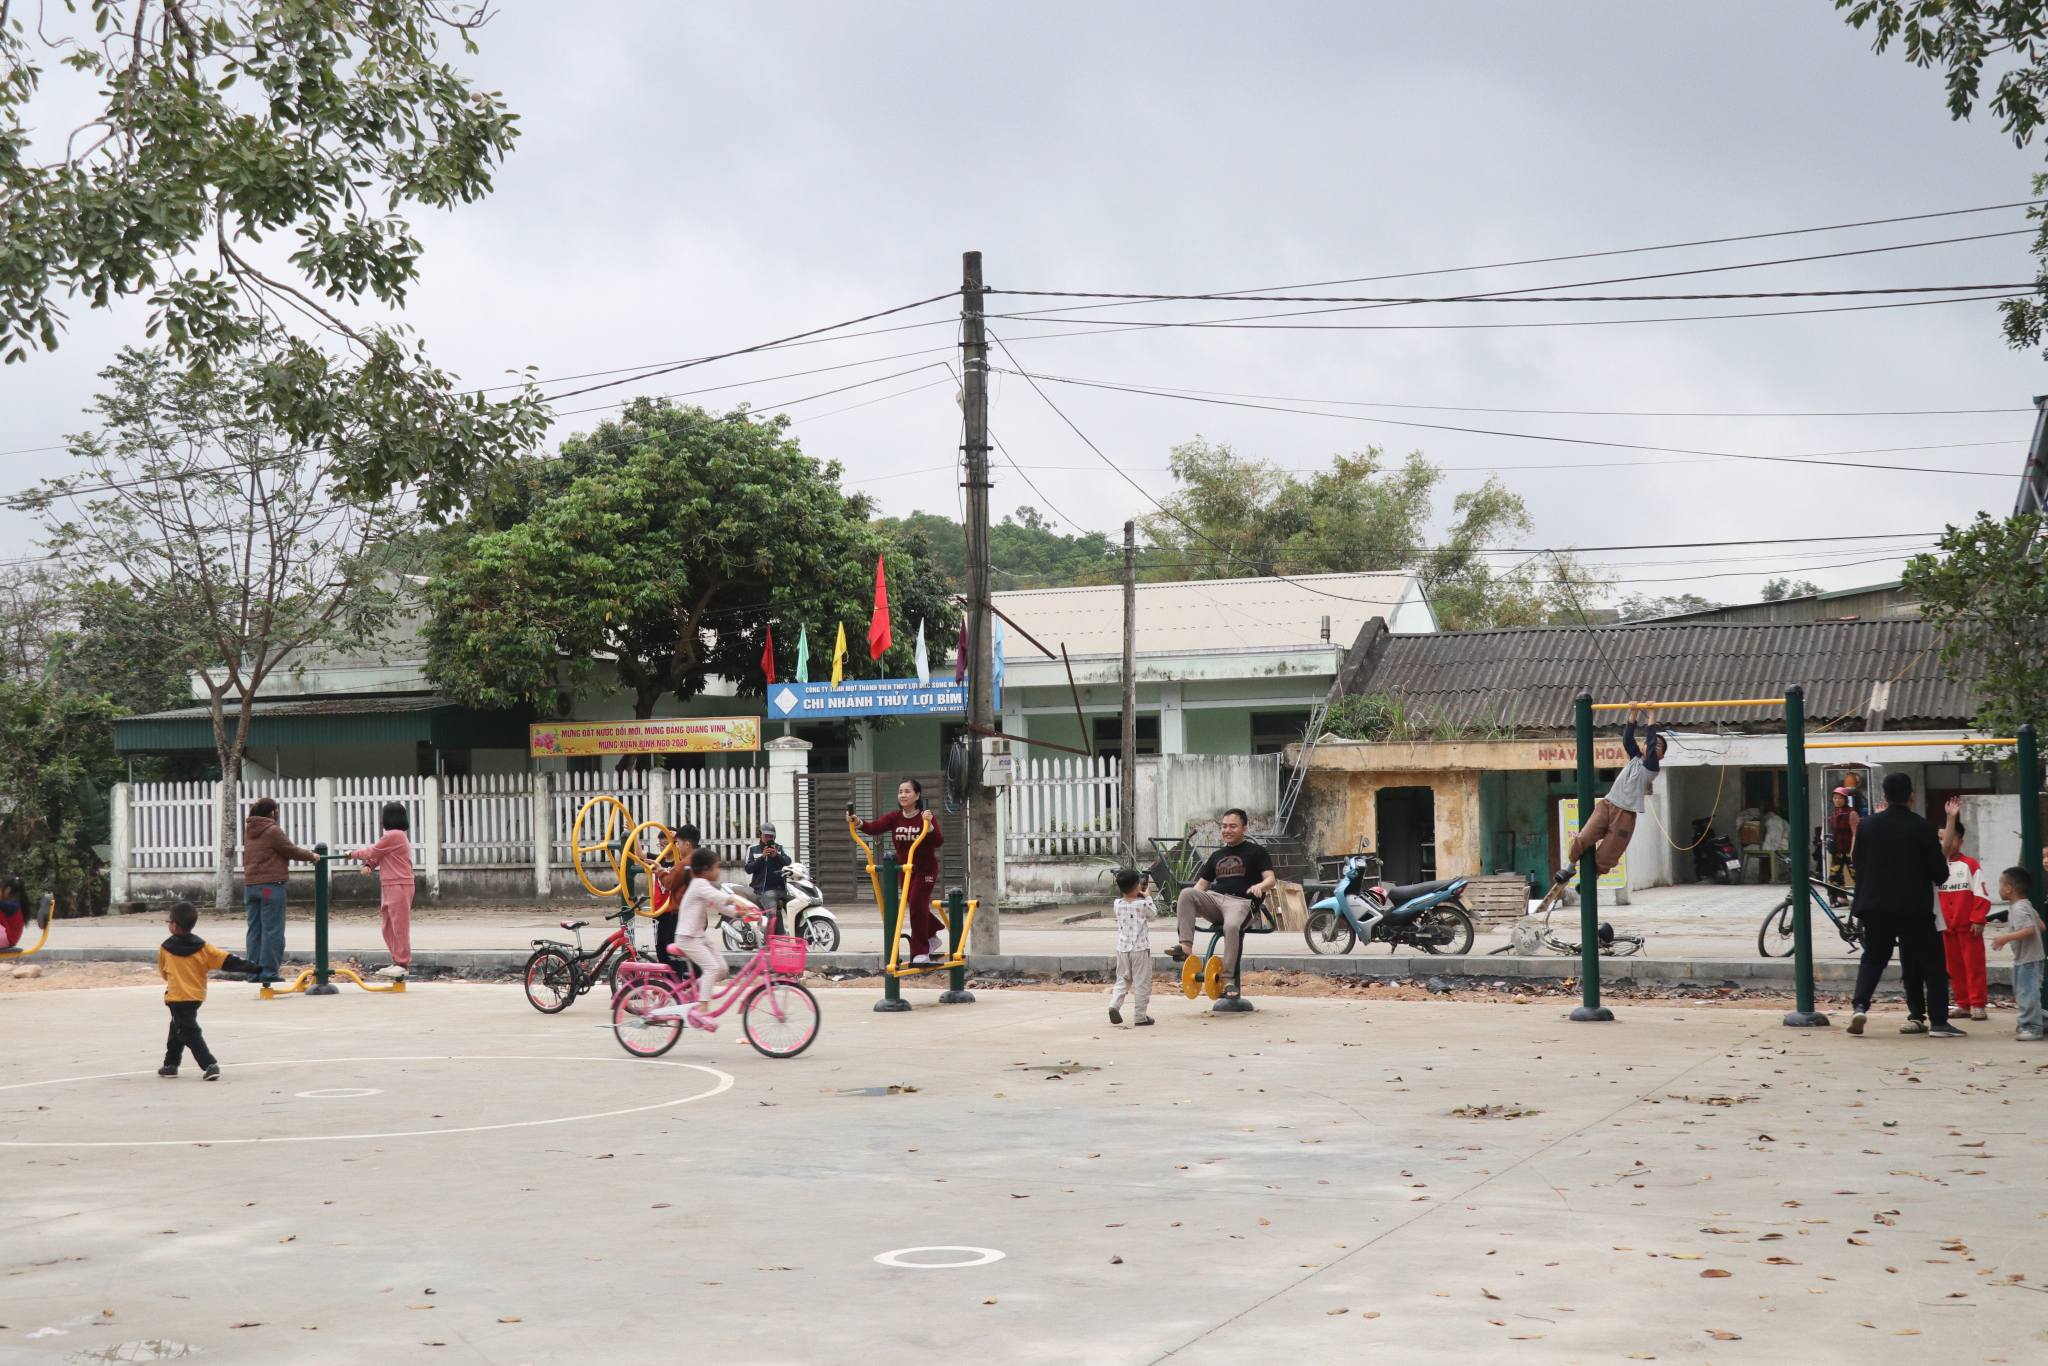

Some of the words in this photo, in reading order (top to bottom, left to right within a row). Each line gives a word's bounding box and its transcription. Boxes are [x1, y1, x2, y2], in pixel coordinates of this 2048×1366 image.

[803, 698, 824, 710] CHI
[828, 694, 873, 709] NHÁNH
[877, 690, 909, 707] THỦY
[912, 693, 934, 708] LỢI
[561, 727, 581, 739] MỪNG
[644, 724, 665, 735] MỪNG
[686, 724, 709, 734] QUANG
[710, 724, 726, 733] VINH
[672, 738, 688, 748] 2026
[895, 825, 921, 833] miu
